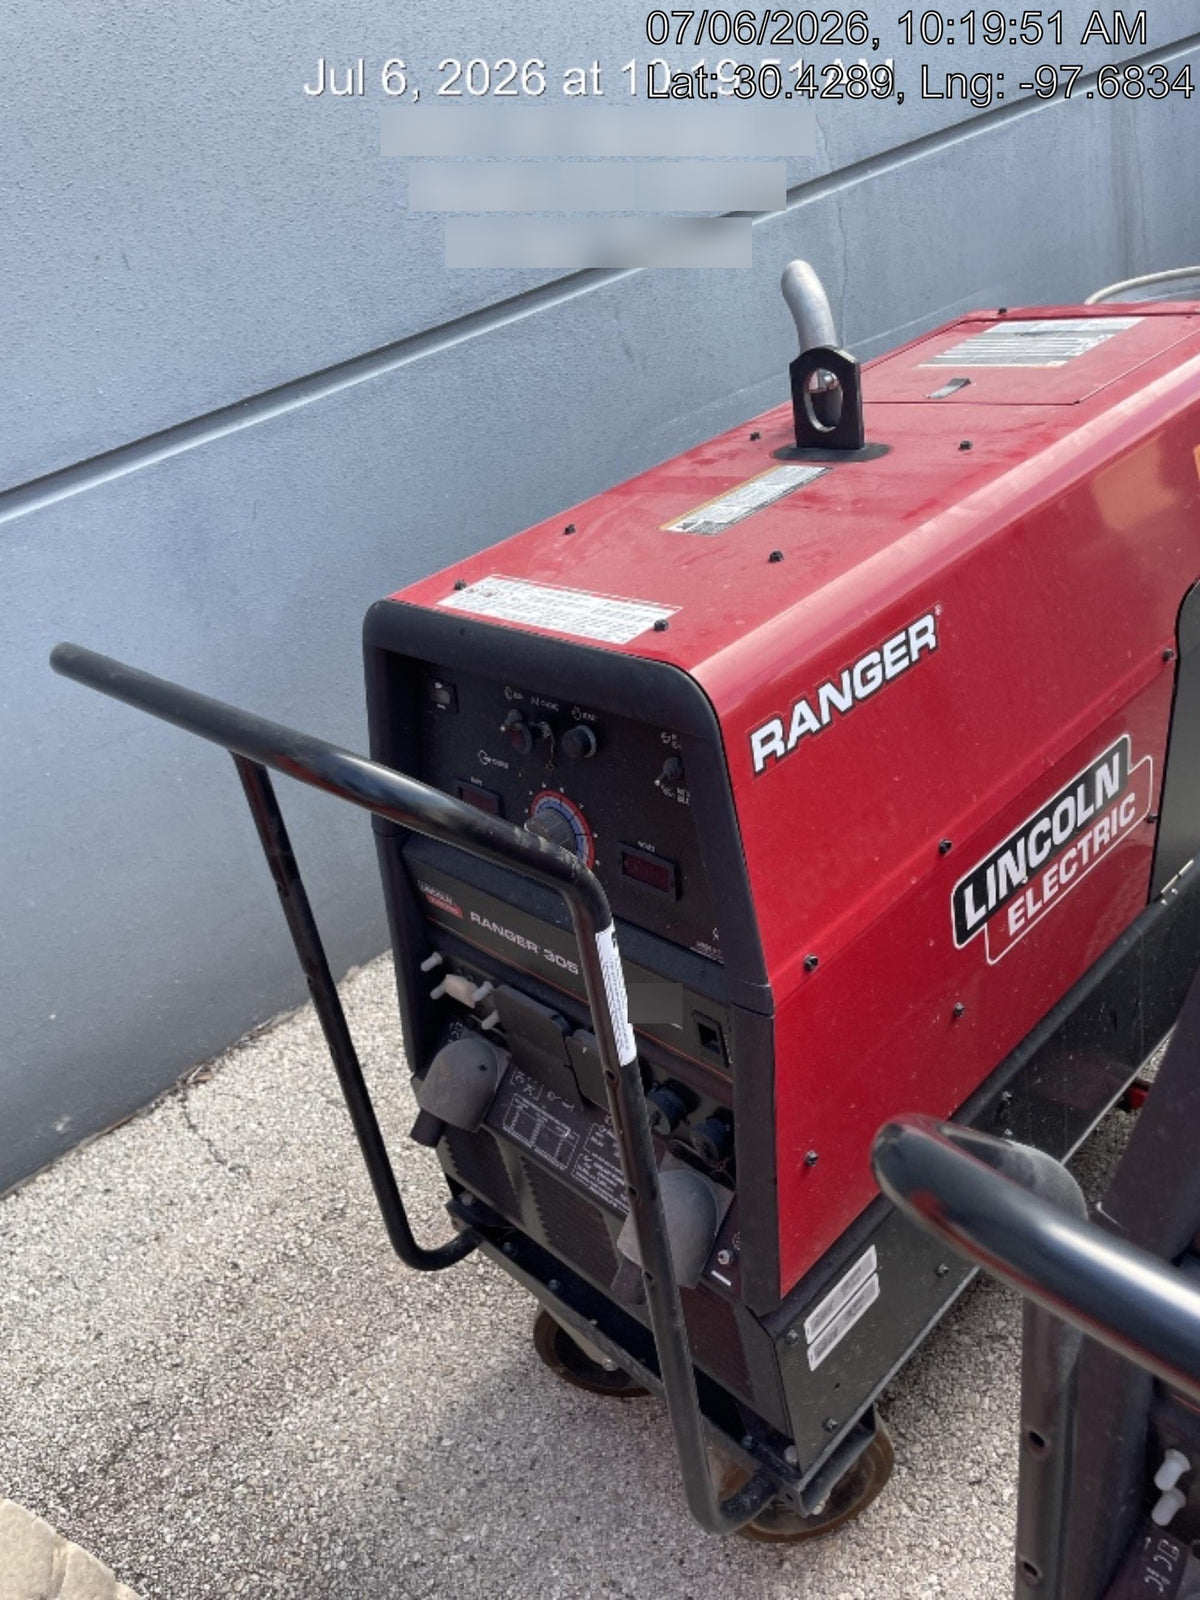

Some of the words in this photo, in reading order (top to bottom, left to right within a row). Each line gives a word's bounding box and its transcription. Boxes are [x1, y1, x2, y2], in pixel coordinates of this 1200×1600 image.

[750, 613, 938, 774] RANGER
[963, 752, 1120, 931] LINCOLN
[1007, 792, 1136, 937] ELECTRIC
[470, 911, 539, 955] RANGER
